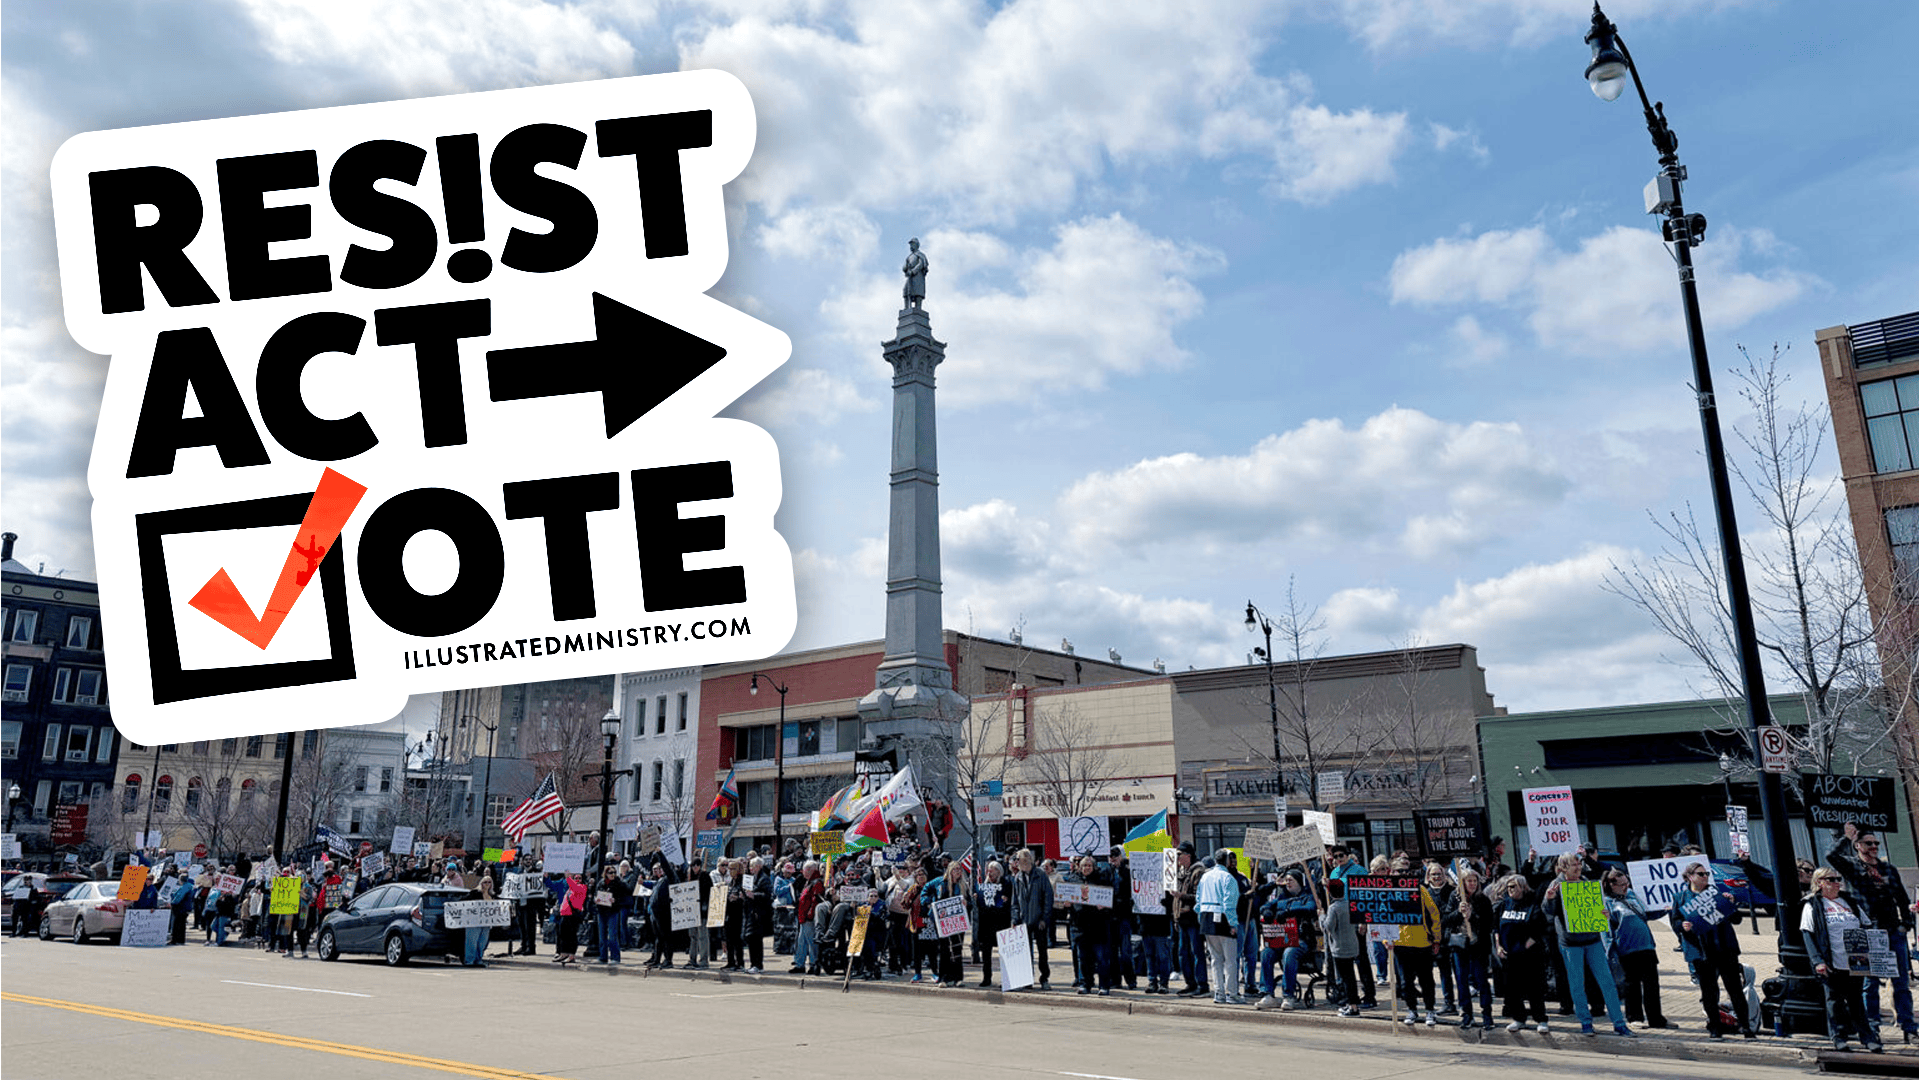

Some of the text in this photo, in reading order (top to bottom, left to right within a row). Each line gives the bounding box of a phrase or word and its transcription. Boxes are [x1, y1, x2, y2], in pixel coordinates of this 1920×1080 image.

[856, 761, 893, 774] HANDS
[1813, 775, 1878, 797] ABORT
[1540, 805, 1558, 815] DO
[1810, 805, 1889, 827] PRESIDENCIES
[1427, 817, 1466, 828] TRUMP IS
[1448, 828, 1476, 839] ABOVE
[1541, 830, 1572, 843] JOB!
[1062, 830, 1108, 852] 2025
[1431, 841, 1471, 851] THE LAW.
[1648, 862, 1678, 881] NO
[273, 877, 297, 889] NOT
[525, 875, 544, 892] MUS
[1349, 877, 1419, 889] HANDS OFF
[1566, 881, 1600, 895] FIRE
[277, 888, 294, 899] MY
[1681, 886, 1718, 914] HANDS
[1350, 901, 1395, 912] SOCIAL
[1567, 895, 1601, 908] MUSK
[1697, 897, 1718, 916] OFF
[466, 907, 478, 915] THE
[1578, 907, 1594, 919] NO
[1365, 912, 1423, 924] SECURITY
[1703, 911, 1725, 925] VA
[1571, 919, 1608, 932] KINGS
[1000, 925, 1025, 945] VETS
